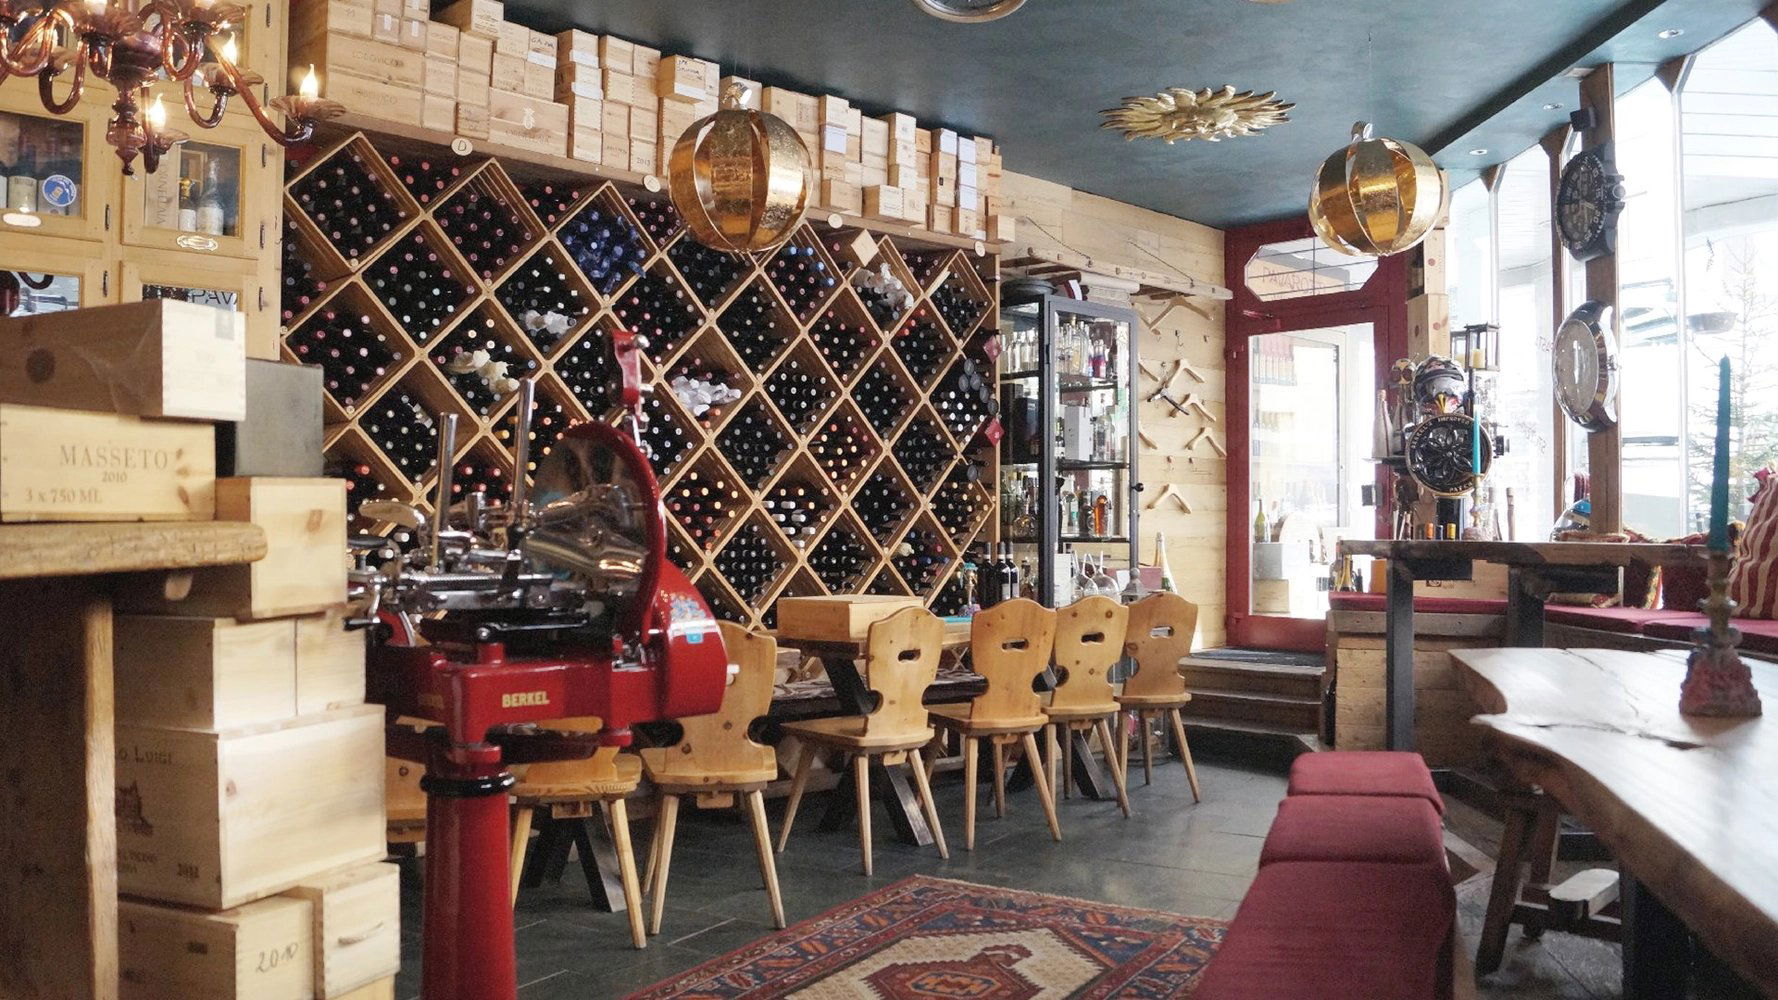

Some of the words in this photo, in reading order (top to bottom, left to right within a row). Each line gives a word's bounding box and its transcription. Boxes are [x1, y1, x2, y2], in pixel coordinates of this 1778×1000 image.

[191, 289, 239, 305] PAV
[60, 444, 168, 470] MASSETO
[101, 471, 128, 483] 2010
[25, 488, 33, 501] 3
[51, 488, 76, 504] 750
[502, 691, 550, 708] BERKEL
